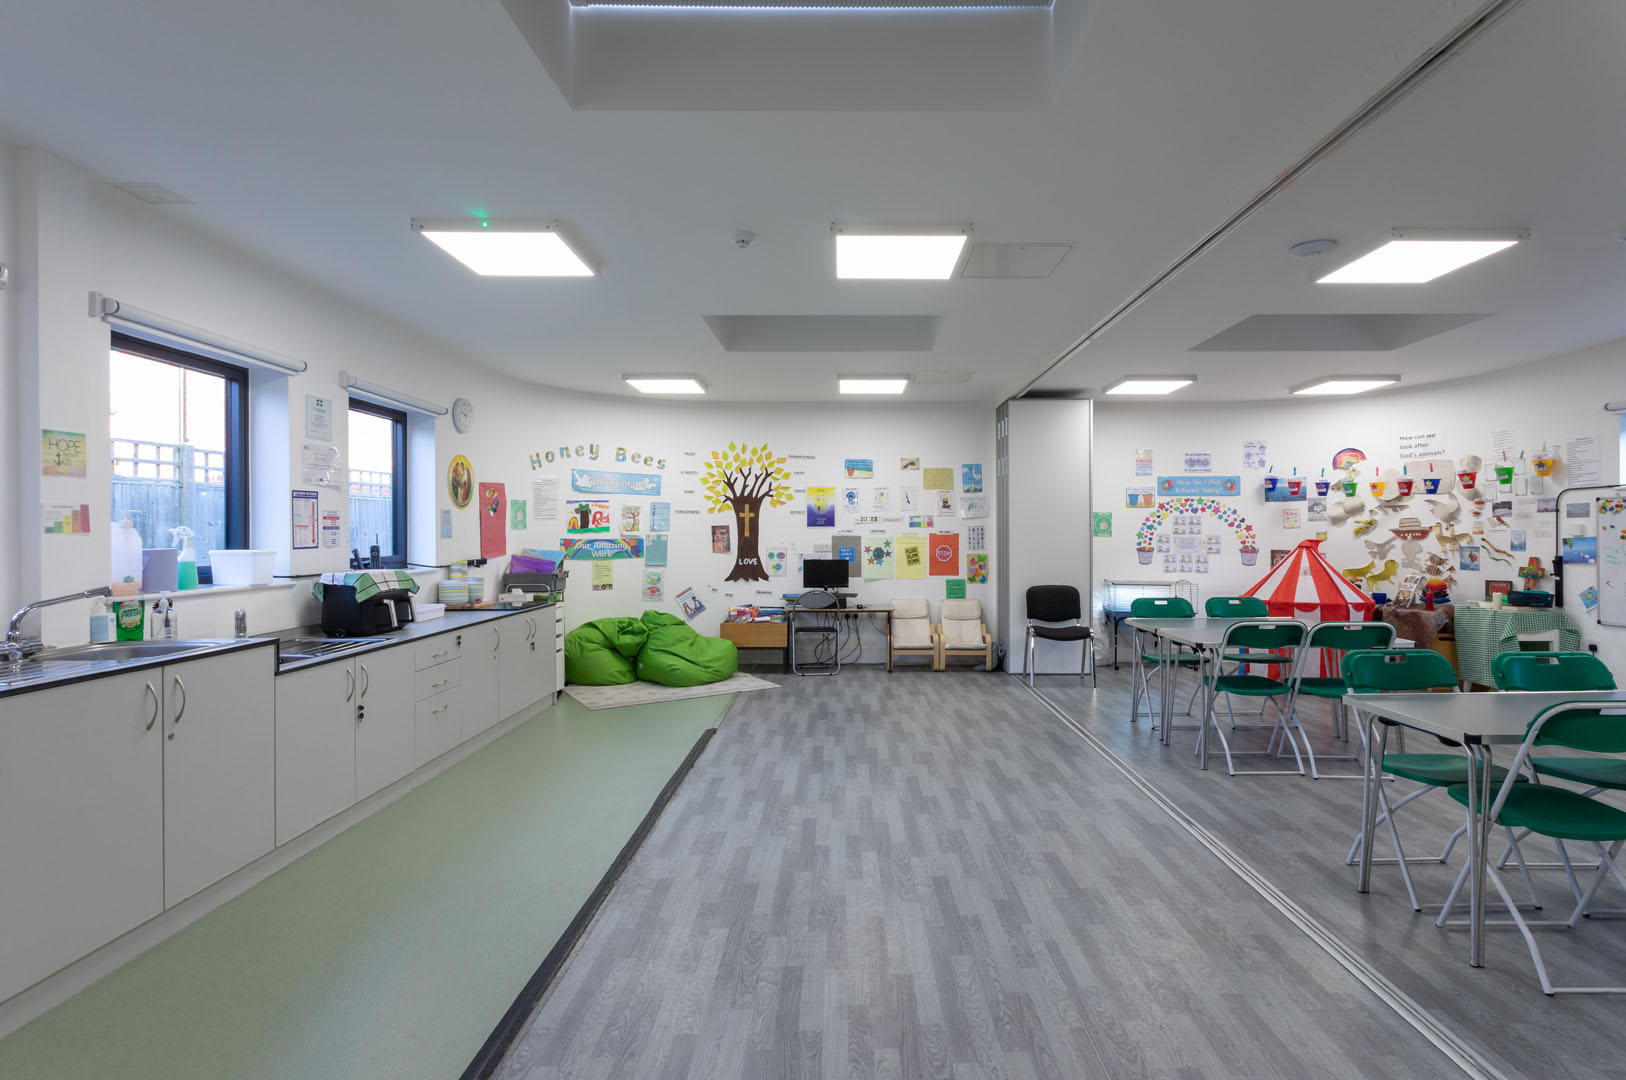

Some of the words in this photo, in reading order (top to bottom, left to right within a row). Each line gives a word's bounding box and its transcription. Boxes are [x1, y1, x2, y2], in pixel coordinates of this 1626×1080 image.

[49, 437, 81, 454] HOPE
[529, 443, 600, 471] Honey
[615, 446, 668, 470] Bees
[576, 541, 592, 549] Our
[594, 541, 627, 551] Amazing
[591, 550, 613, 558] Work
[738, 558, 758, 566] LOVE
